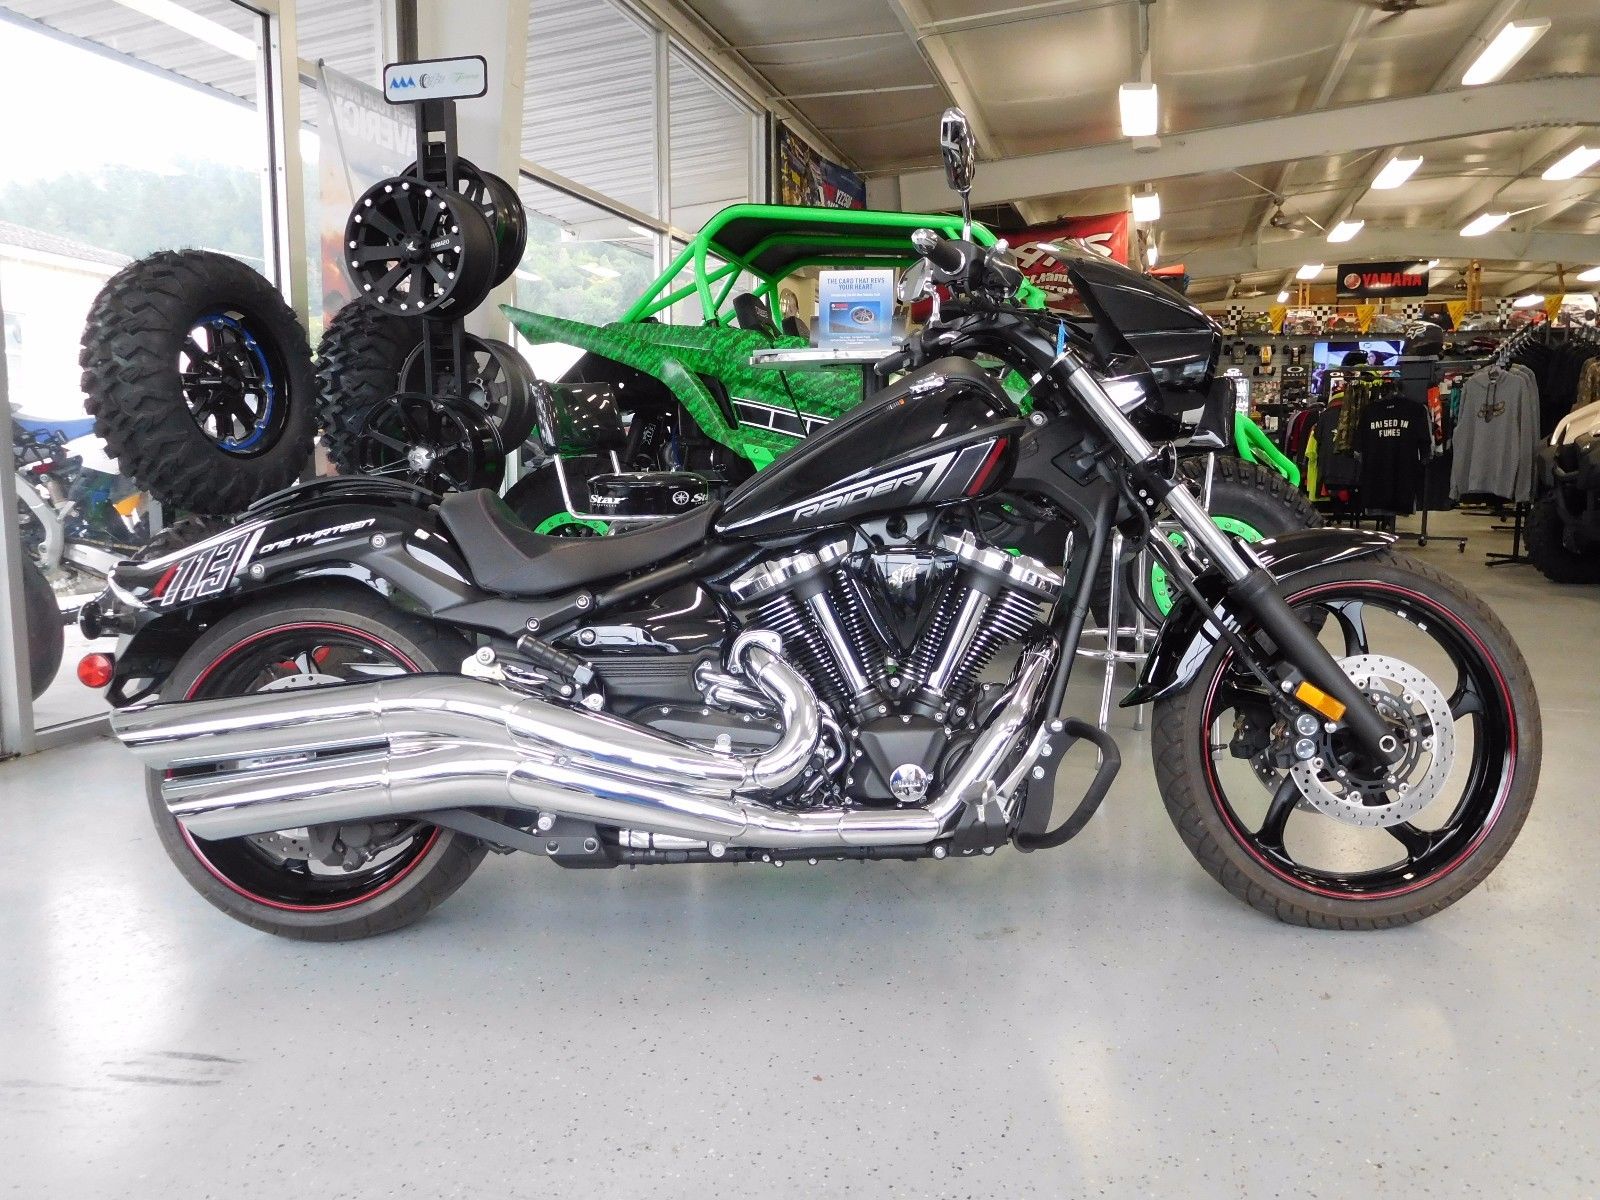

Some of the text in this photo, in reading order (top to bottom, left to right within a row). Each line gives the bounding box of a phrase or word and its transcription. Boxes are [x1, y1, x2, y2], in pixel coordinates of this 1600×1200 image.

[1362, 272, 1423, 288] YAMAHA
[1370, 419, 1409, 430] RAISED IN
[1379, 428, 1401, 438] FUMES
[589, 494, 629, 504] Star
[792, 471, 924, 523] RAIDER
[259, 518, 376, 555] ONE THIRTEEN
[160, 533, 252, 608] 113
